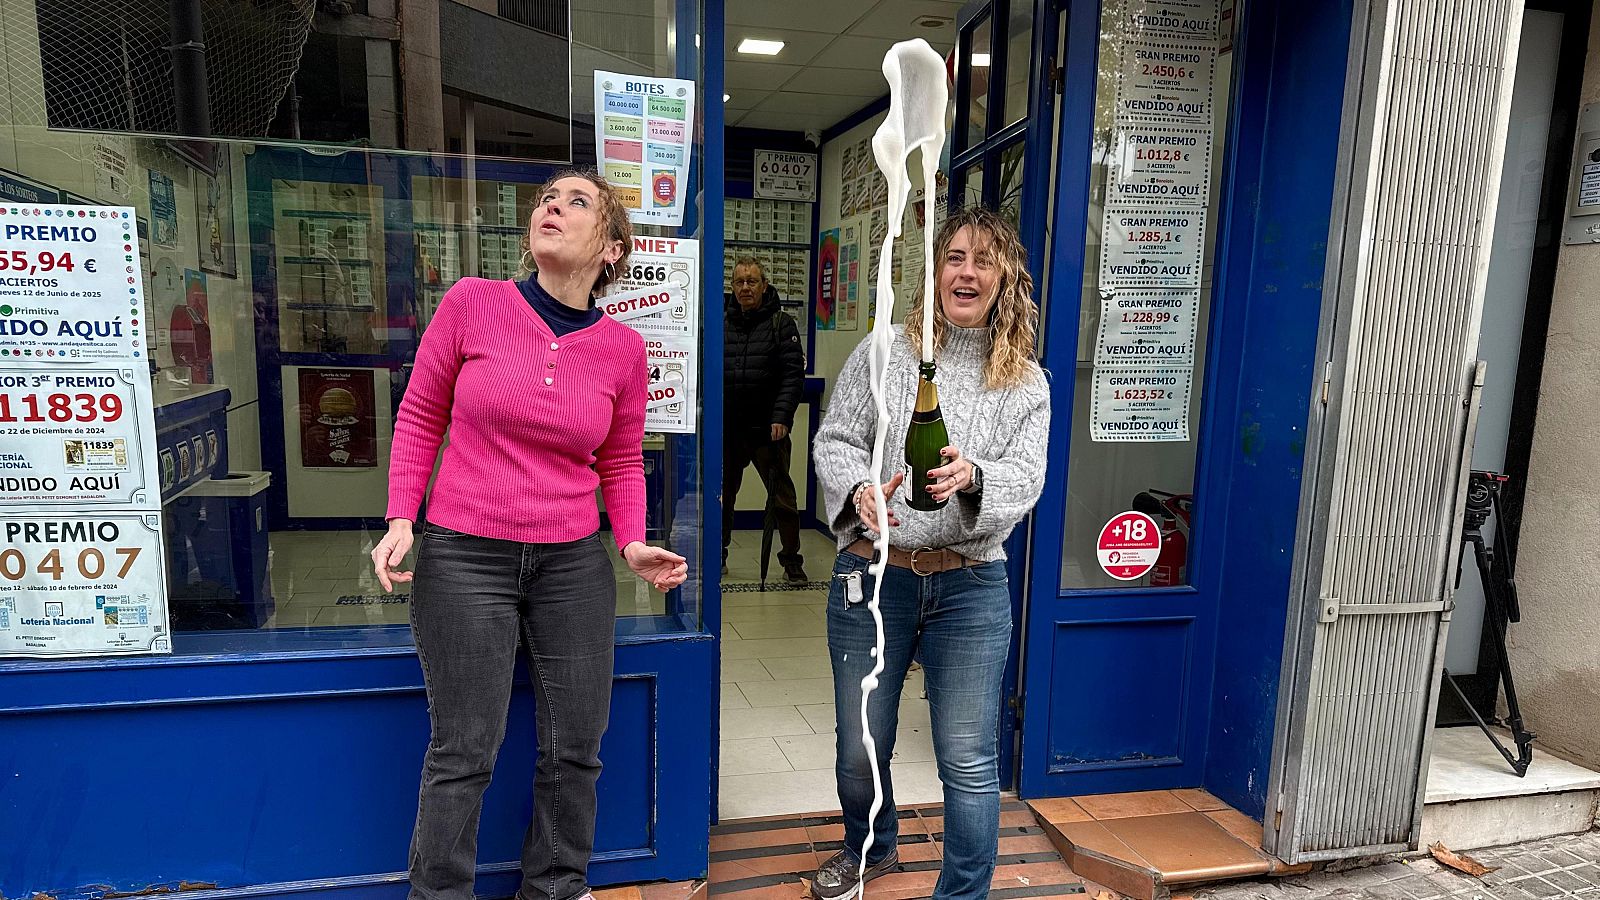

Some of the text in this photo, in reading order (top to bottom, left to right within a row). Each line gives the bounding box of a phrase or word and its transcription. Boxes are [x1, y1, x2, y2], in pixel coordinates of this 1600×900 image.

[1130, 15, 1180, 28] VENDIDO
[1182, 19, 1209, 32] AQUÍ
[1135, 50, 1200, 63] GRAN PREMIO
[1142, 64, 1195, 80] 2.450,6 €
[625, 81, 665, 94] BOTES
[1125, 100, 1174, 111] VENDIDO
[1177, 102, 1204, 116] AQUÍ
[1129, 135, 1197, 146] GRAN PREMIO
[775, 154, 806, 164] PREMIO
[1137, 149, 1189, 163] 1.012,8 €
[760, 161, 811, 177] 60407
[1118, 184, 1200, 197] VENDIDO AQUÍ
[1120, 218, 1189, 228] GRAN PREMIO
[6, 225, 97, 243] PREMIO
[1128, 231, 1181, 245] 1.285,1 €
[634, 240, 679, 256] NIET
[84, 258, 97, 273] €
[1110, 264, 1191, 277] VENDIDO AQUÍ
[0, 278, 59, 288] ACIERTOS
[23, 289, 33, 297] 12
[35, 289, 46, 297] de
[47, 290, 68, 298] Junio
[82, 291, 102, 299] 2025
[1118, 299, 1182, 308] GRAN PREMIO
[15, 306, 60, 316] Primitiva
[1121, 312, 1179, 325] 1.228,99 €
[57, 316, 123, 341] AQUÍ
[648, 350, 689, 360] NOLITA"
[1106, 343, 1186, 356] VENDIDO AQUÍ
[56, 377, 115, 388] PREMIO
[1109, 377, 1176, 386] GRAN PREMIO
[1113, 389, 1164, 401] 1.623,52
[0, 394, 122, 422] 11839
[33, 428, 73, 436] Diciembre
[86, 427, 105, 435] 2024
[1100, 419, 1179, 432] VENDIDO AQUÍ
[84, 442, 115, 450] 11839
[70, 473, 119, 491] AQUÍ
[6, 521, 119, 543] PREMIO
[1112, 519, 1147, 541] +18
[53, 616, 94, 626] Nacional
